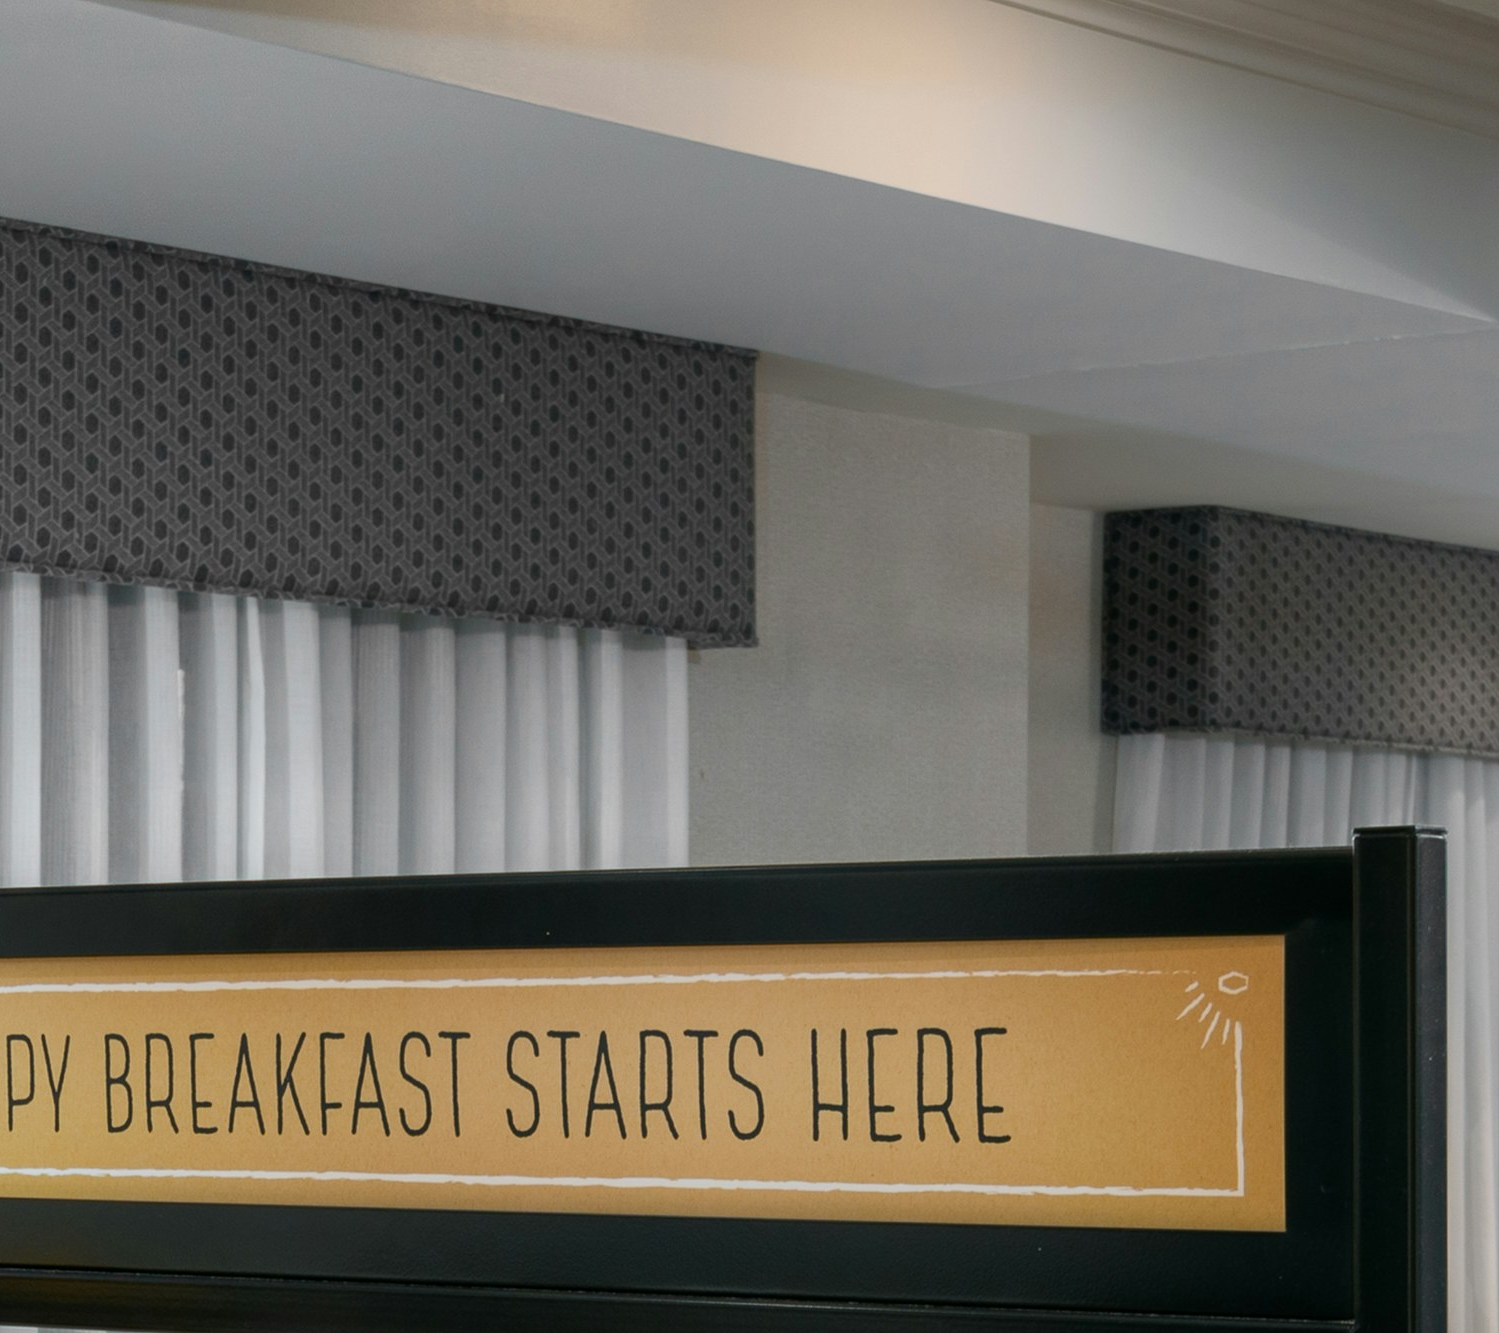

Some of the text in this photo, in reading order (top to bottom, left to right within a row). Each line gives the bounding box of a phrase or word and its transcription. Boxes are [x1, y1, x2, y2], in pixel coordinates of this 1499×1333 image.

[105, 1029, 472, 1137] BREAKFAST
[505, 1029, 766, 1141] STARTS
[811, 1027, 1013, 1144] HERE
